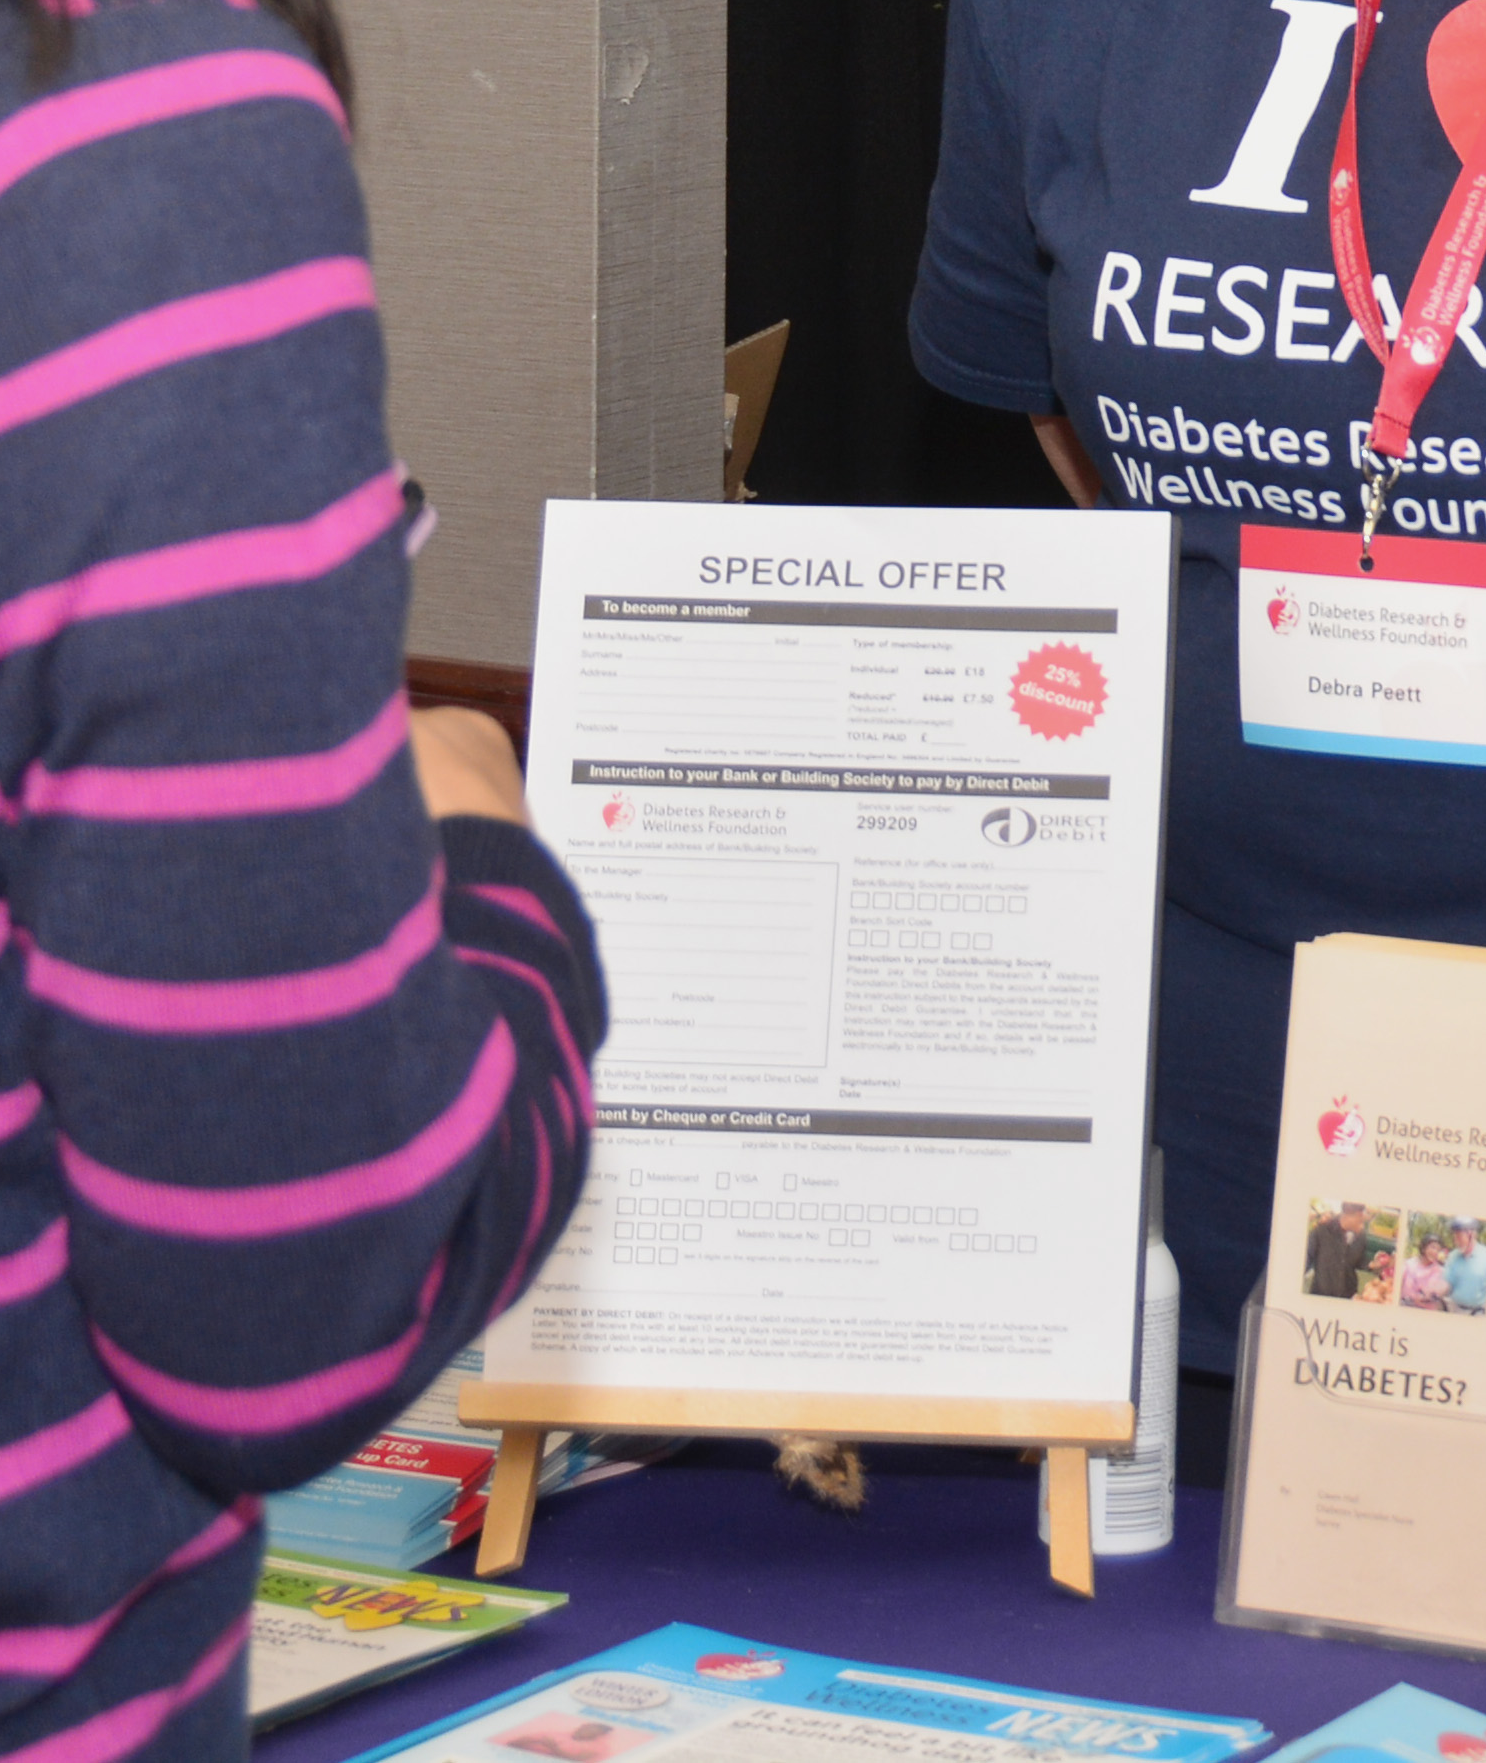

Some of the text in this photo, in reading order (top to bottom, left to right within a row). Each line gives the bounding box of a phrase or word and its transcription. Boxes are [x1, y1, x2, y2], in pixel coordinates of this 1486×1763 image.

[1421, 254, 1455, 320] Diabetes
[1445, 189, 1481, 253] Research
[1437, 260, 1472, 326] Wellness
[1098, 395, 1330, 466] Diabetes
[1113, 453, 1346, 523] Wellness
[699, 556, 1007, 591] SPECIAL OFFER
[602, 599, 750, 617] To become a member
[1309, 602, 1466, 628] Diabetes Research &
[1308, 622, 1468, 649] Wellness Foundation
[580, 650, 623, 659] Surname
[580, 669, 618, 677] Address
[850, 665, 898, 674] Individual
[1044, 663, 1081, 688] 25%
[962, 693, 994, 704] £7.50
[1019, 681, 1095, 715] discount
[1308, 676, 1422, 703] Debra Peett
[575, 723, 619, 733] Postcode
[847, 731, 906, 742] TOTAL PAID
[589, 762, 1049, 792] Instruction to your Bank or Building Society to pay by Direct Debit
[643, 804, 786, 821] Diabetes Research &
[857, 815, 917, 831] 299209
[1039, 815, 1108, 827] DIRECT
[642, 820, 787, 836] Wellness Foundation
[1040, 828, 1108, 842] Debit
[630, 1108, 648, 1124] by
[652, 1110, 706, 1124] Cheque
[710, 1110, 725, 1125] or
[729, 1111, 772, 1126] Credit
[776, 1112, 810, 1127] Card
[1377, 1116, 1462, 1144] Diabetes
[1375, 1139, 1461, 1168] Wellness
[734, 1173, 758, 1184] VISA
[1301, 1318, 1408, 1357] What is
[1294, 1357, 1466, 1405] DIABETES?
[384, 1454, 429, 1470] Card
[985, 1709, 1179, 1752] NEWS
